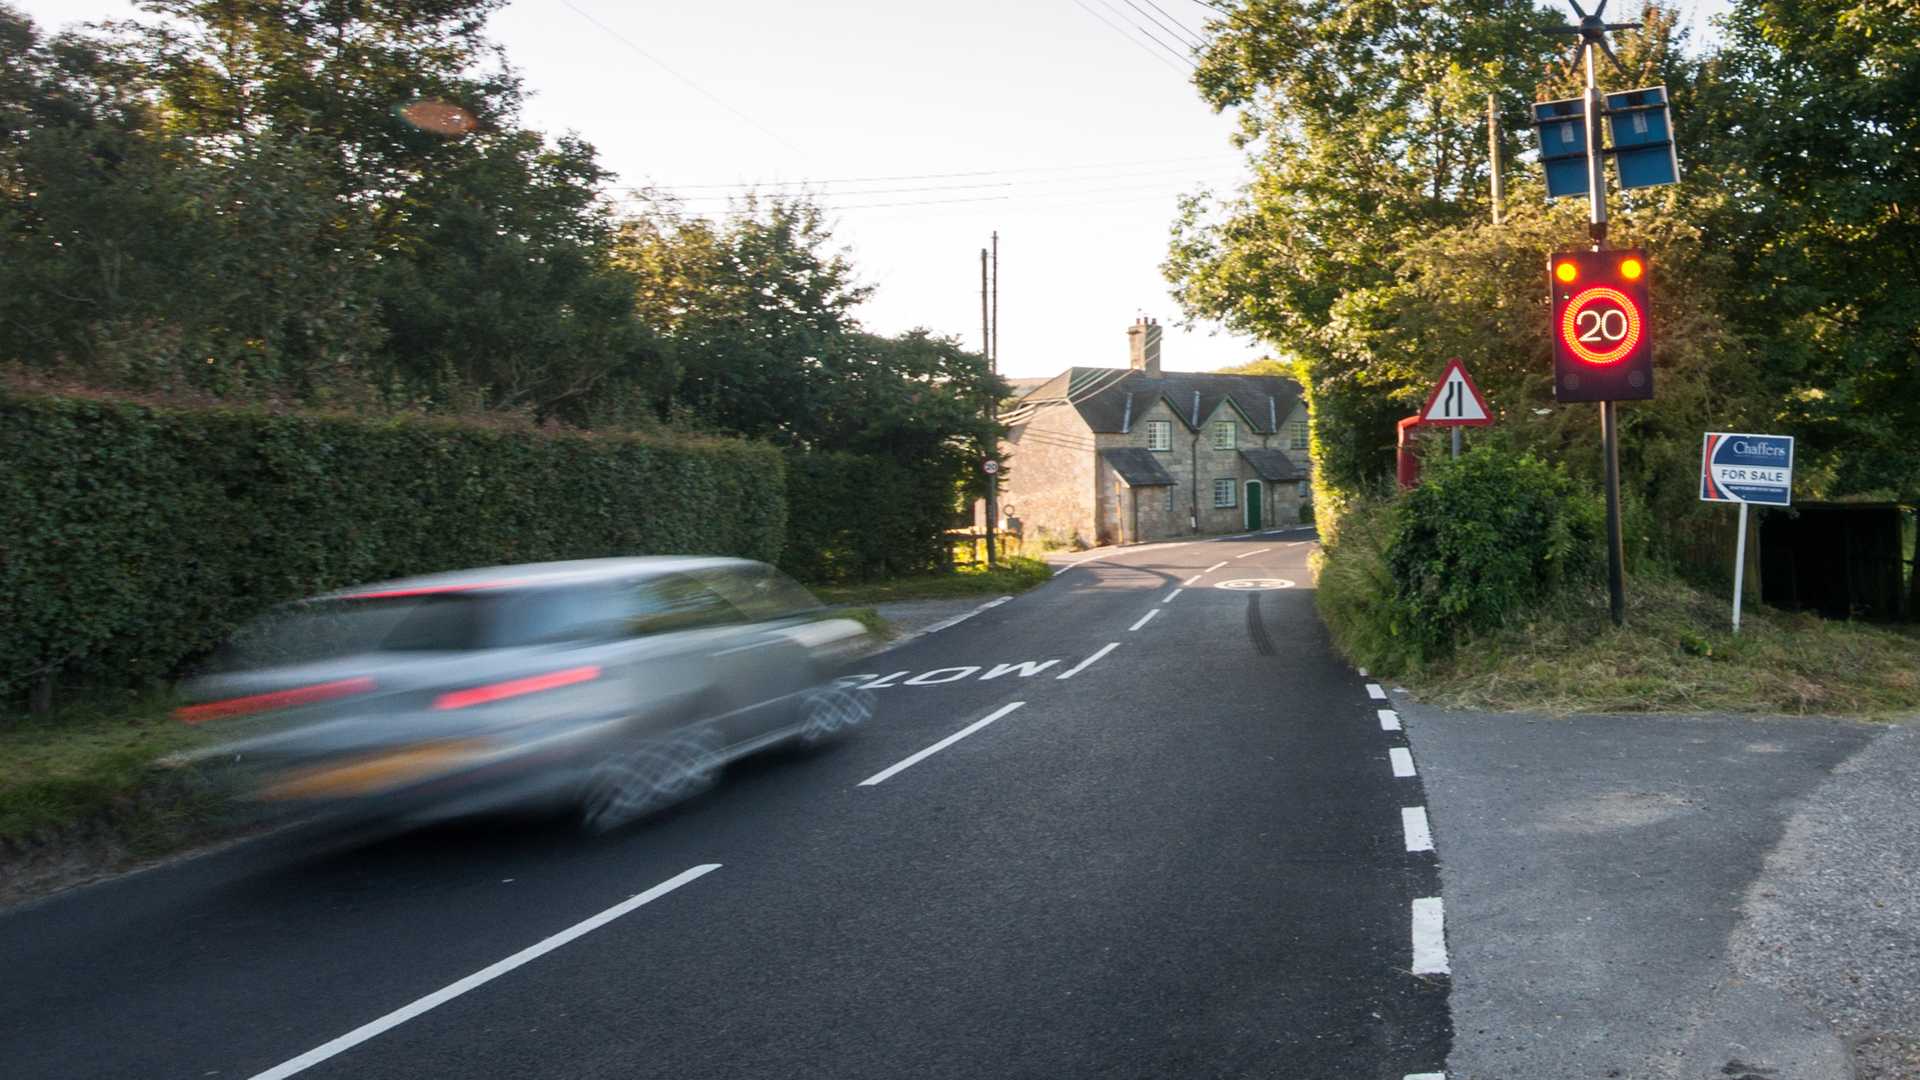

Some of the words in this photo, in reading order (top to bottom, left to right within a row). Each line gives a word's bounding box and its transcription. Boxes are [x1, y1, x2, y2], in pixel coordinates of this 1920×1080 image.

[1576, 309, 1628, 342] 20
[1721, 469, 1746, 480] FOR
[1751, 470, 1784, 482] SALE
